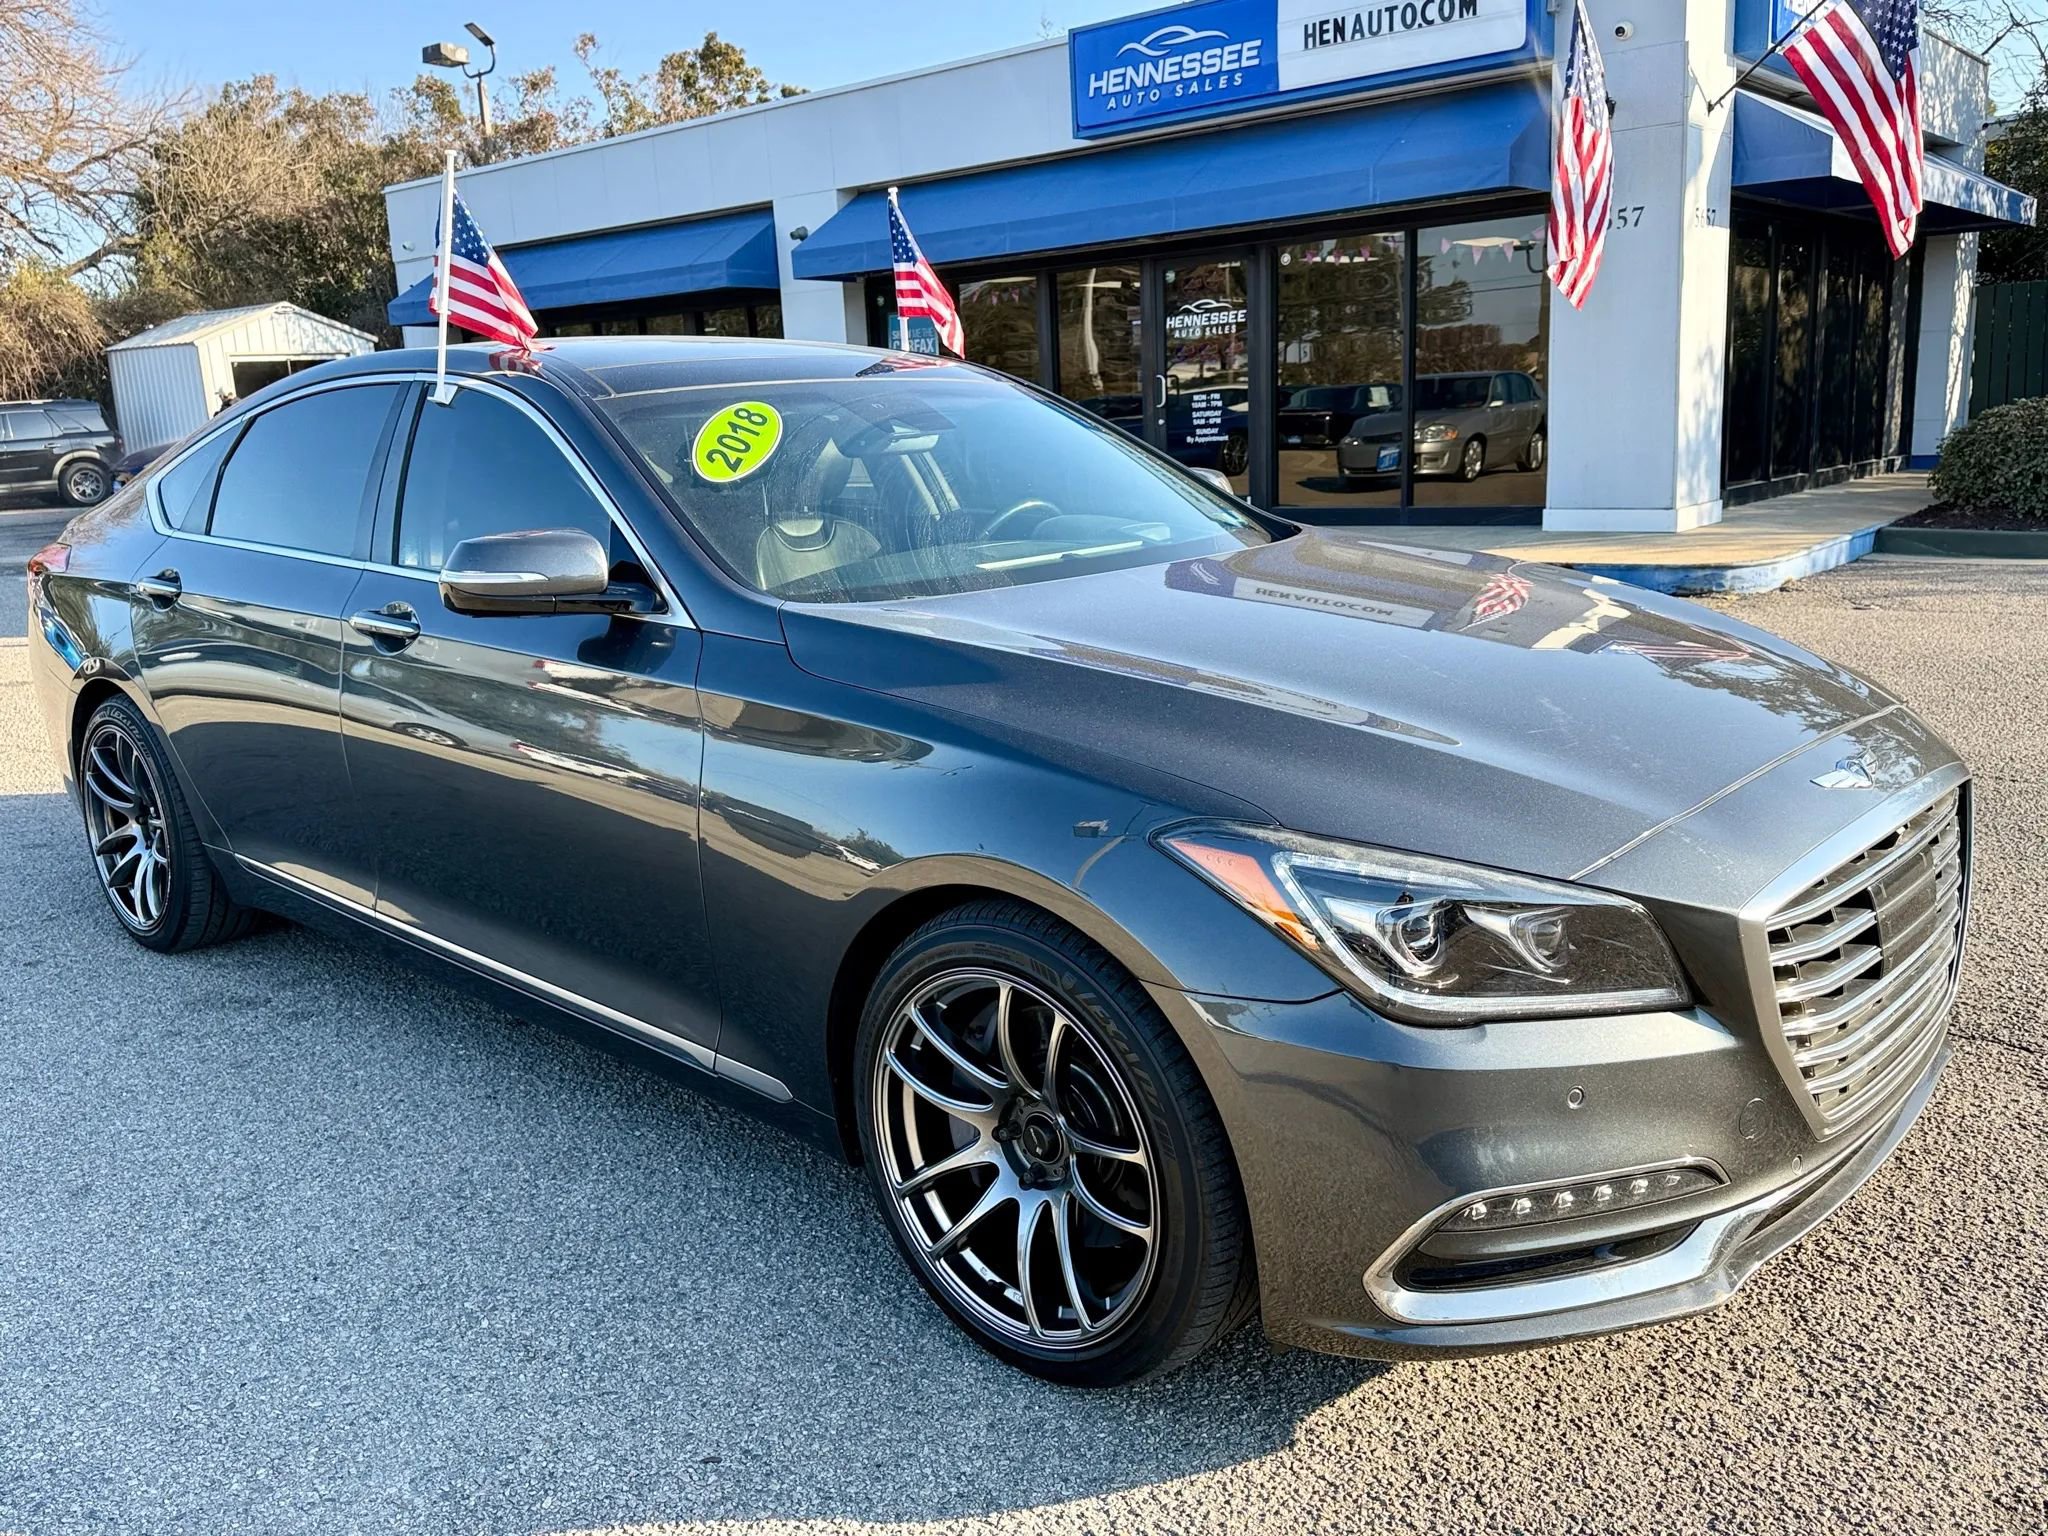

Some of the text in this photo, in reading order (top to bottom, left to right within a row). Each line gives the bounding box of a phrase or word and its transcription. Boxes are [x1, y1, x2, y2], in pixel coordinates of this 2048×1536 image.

[1304, 0, 1477, 49] HENAUTO.COM
[1088, 38, 1262, 98] HENNESSEE
[1107, 72, 1244, 110] AUTO SALES
[1166, 309, 1247, 329] HENNESSEE
[1174, 324, 1237, 338] AUTO SALES
[893, 338, 935, 352] CRFAX
[1192, 410, 1222, 418] SATURDAY
[706, 407, 768, 473] 2018
[1186, 434, 1229, 444] By Appointment
